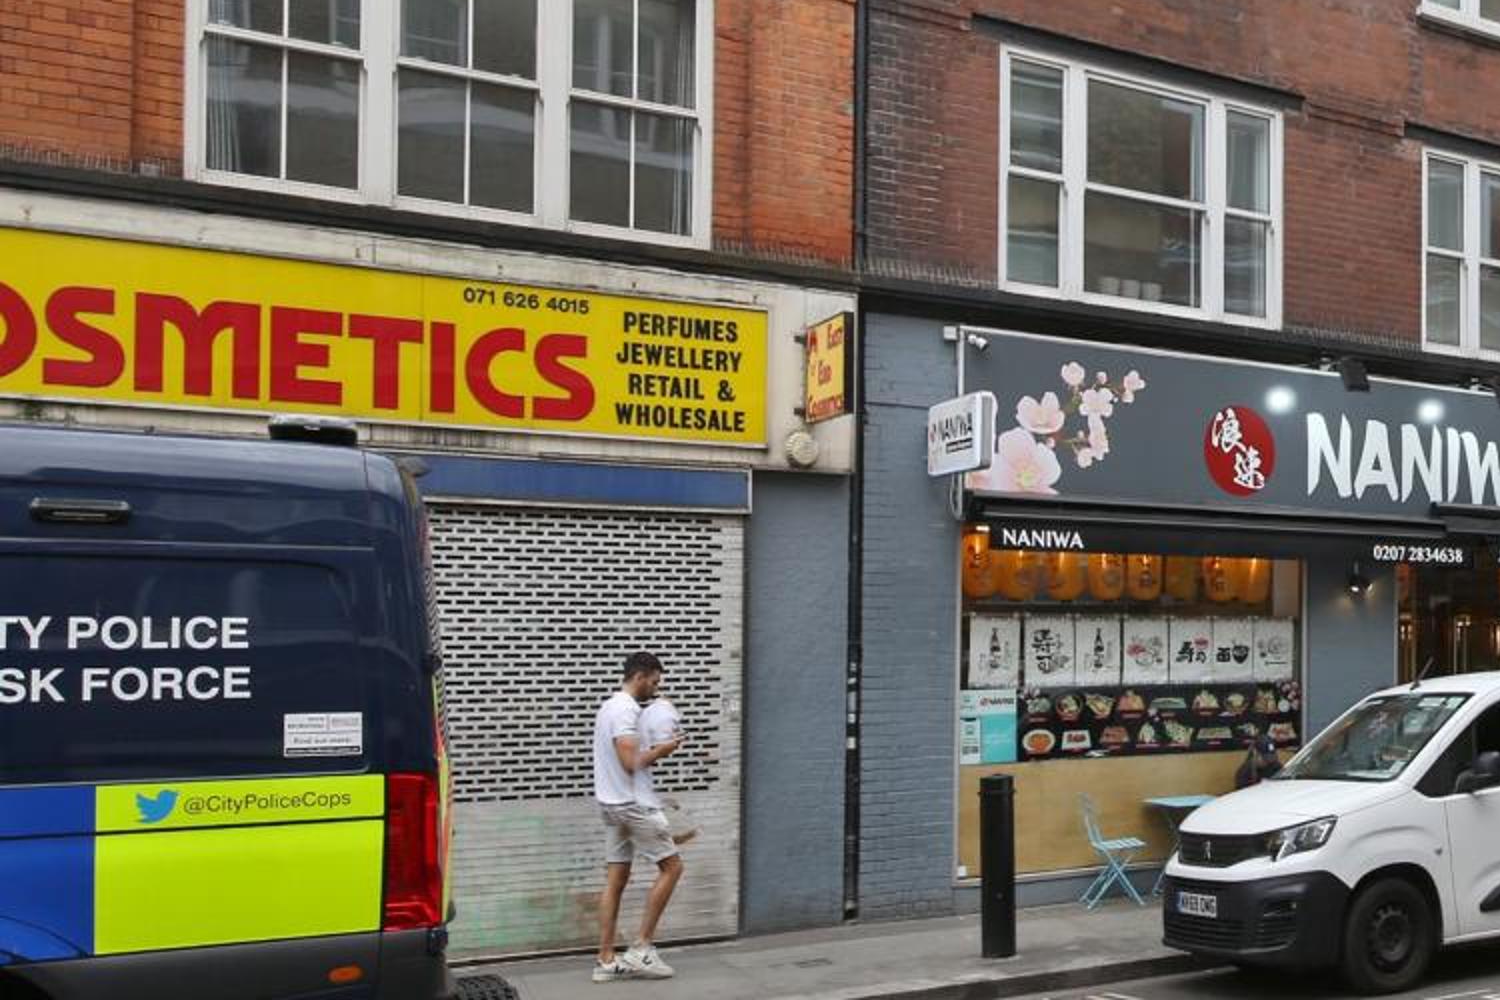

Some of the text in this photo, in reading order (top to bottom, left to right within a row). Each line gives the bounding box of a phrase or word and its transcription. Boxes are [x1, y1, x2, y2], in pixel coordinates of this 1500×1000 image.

[463, 287, 590, 315] 071 626 4015
[623, 311, 739, 343] PERFUMES
[616, 343, 742, 373] JEWELLERY
[628, 373, 736, 402] RETAIL &
[615, 402, 746, 433] WHOLESALE
[1003, 528, 1084, 549] NANIWA
[1373, 545, 1463, 563] 0207 2834638
[67, 615, 250, 651] POLICE
[82, 665, 252, 701] FORCE
[184, 791, 352, 815] @CityPoliceCops
